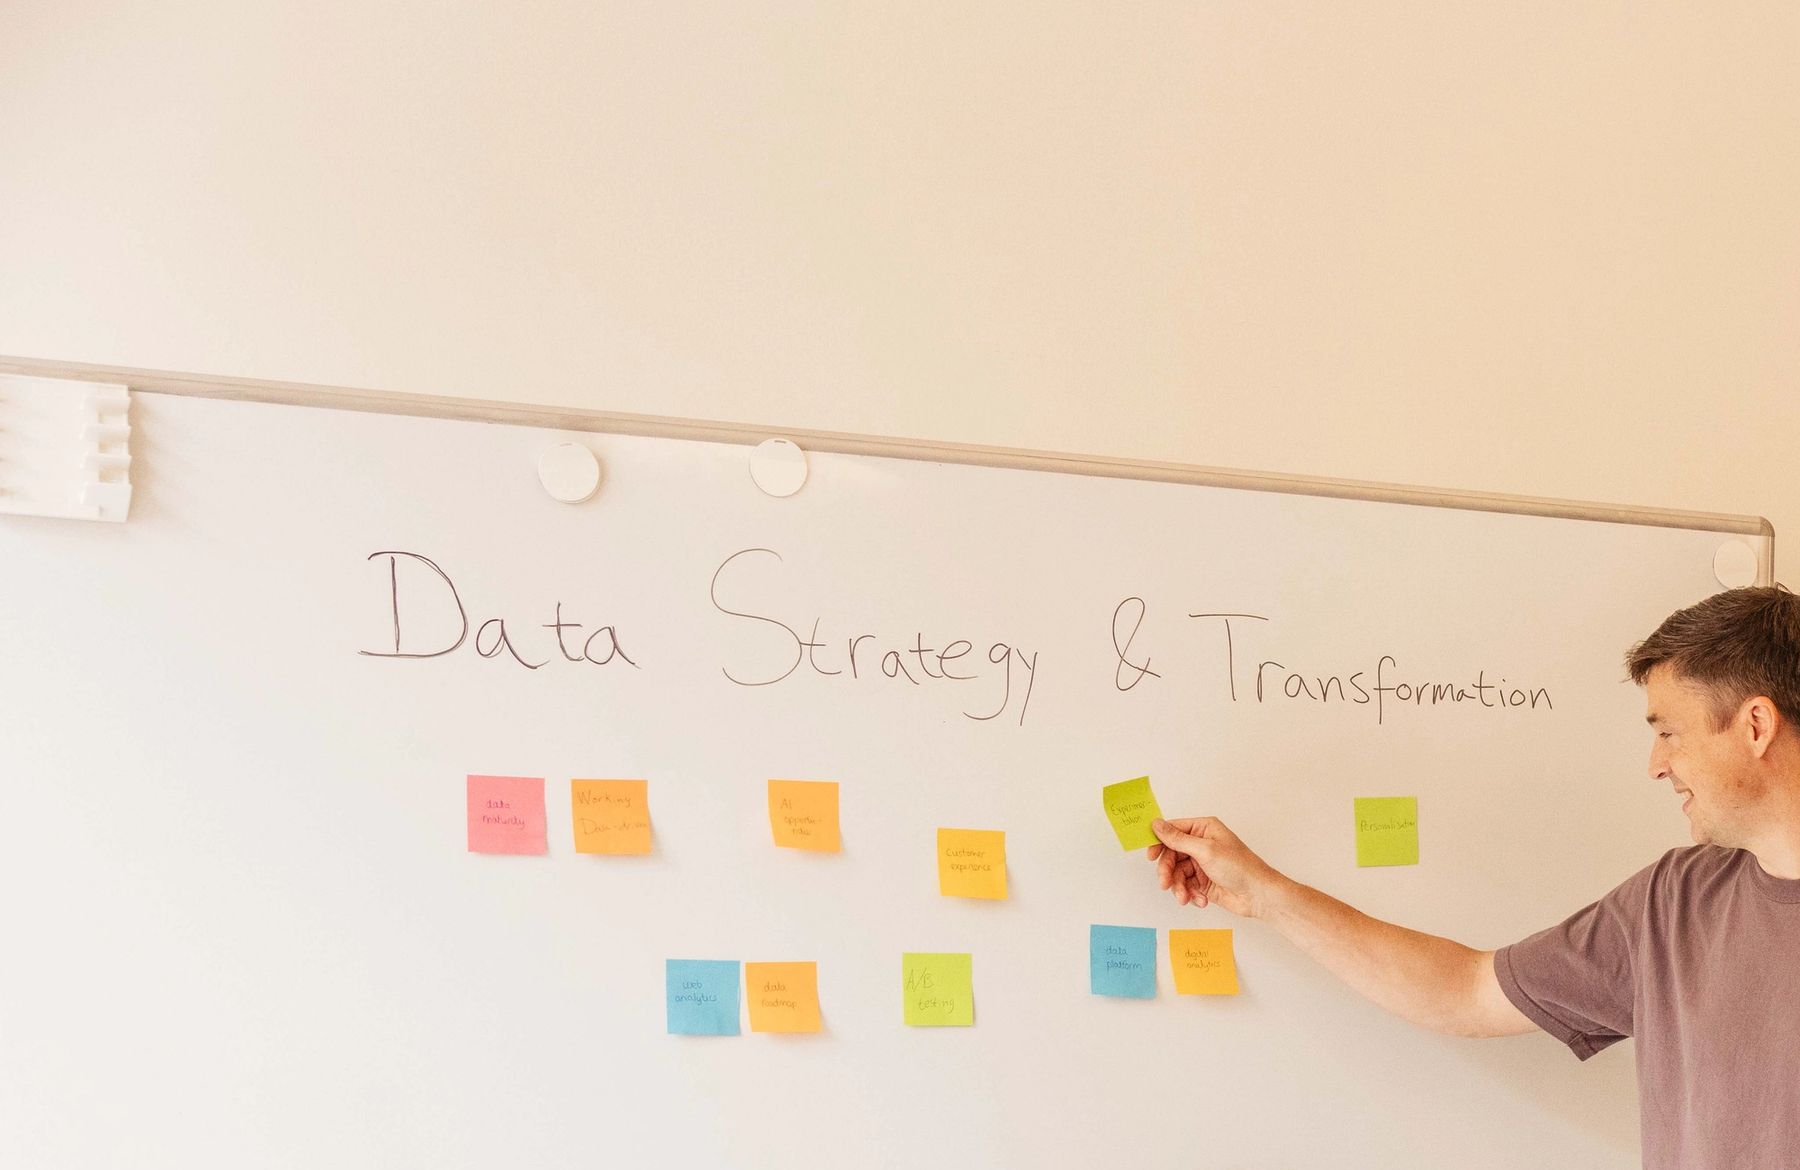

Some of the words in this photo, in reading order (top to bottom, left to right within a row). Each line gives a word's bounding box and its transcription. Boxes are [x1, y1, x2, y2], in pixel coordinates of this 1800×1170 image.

[358, 550, 641, 669] Data
[710, 547, 1039, 727] Strategy
[1111, 596, 1162, 691] &
[1188, 612, 1553, 725] Transformation
[486, 799, 511, 809] data
[576, 789, 632, 808] Working
[482, 814, 526, 830] maturity
[1105, 945, 1128, 956] data
[1106, 959, 1143, 973] platform
[682, 980, 702, 990] web
[763, 981, 786, 992] data
[674, 993, 718, 1006] analytics
